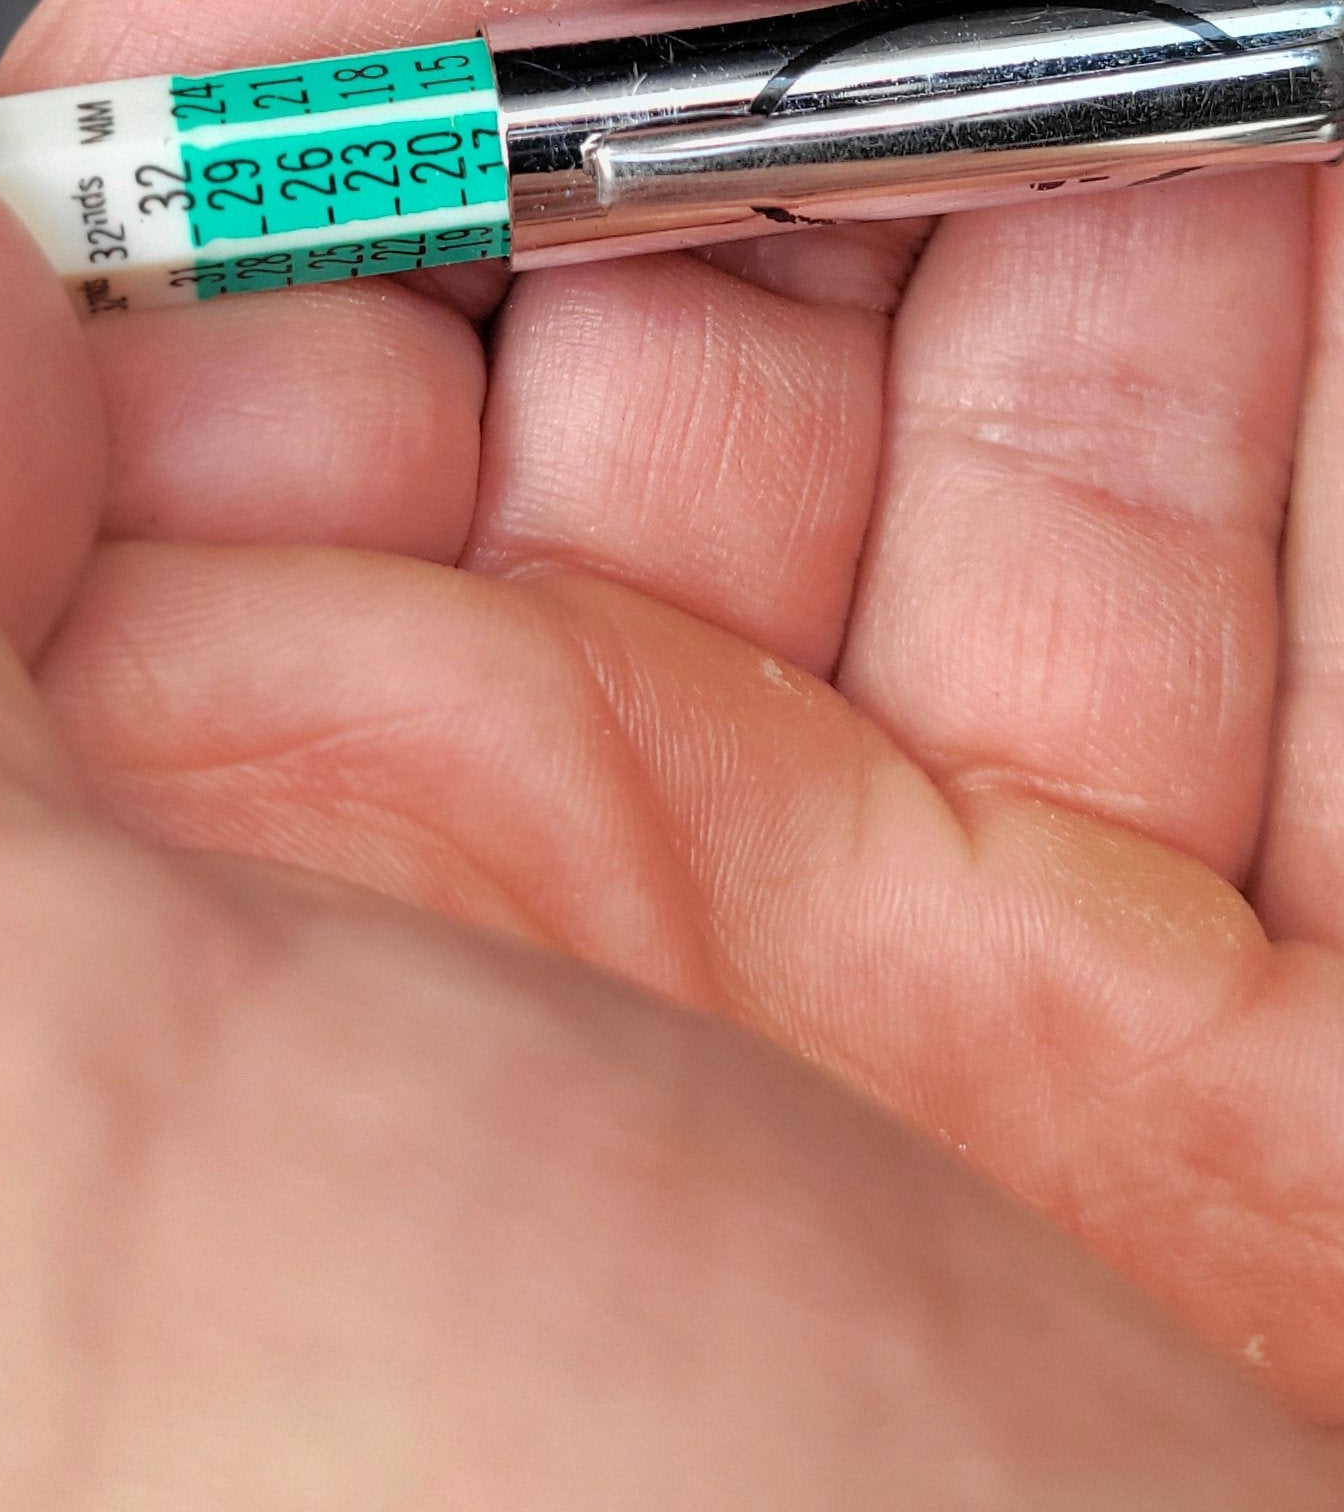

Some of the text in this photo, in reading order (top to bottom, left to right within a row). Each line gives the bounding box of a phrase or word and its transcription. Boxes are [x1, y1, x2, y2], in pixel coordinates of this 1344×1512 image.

[333, 63, 395, 100] 18
[415, 54, 475, 90] 15
[169, 82, 226, 119] 24
[249, 75, 308, 110] 21
[77, 100, 114, 144] MM
[340, 139, 400, 192] 23
[407, 130, 467, 184] 20
[471, 128, 506, 175] 17
[134, 159, 196, 216] 32
[202, 158, 264, 211] 29
[277, 147, 338, 201] 26
[71, 175, 129, 264] 32nds
[309, 242, 365, 270] 25
[370, 234, 427, 262] 22
[436, 225, 494, 253] 19
[168, 261, 226, 287] 31
[236, 252, 294, 281] 28
